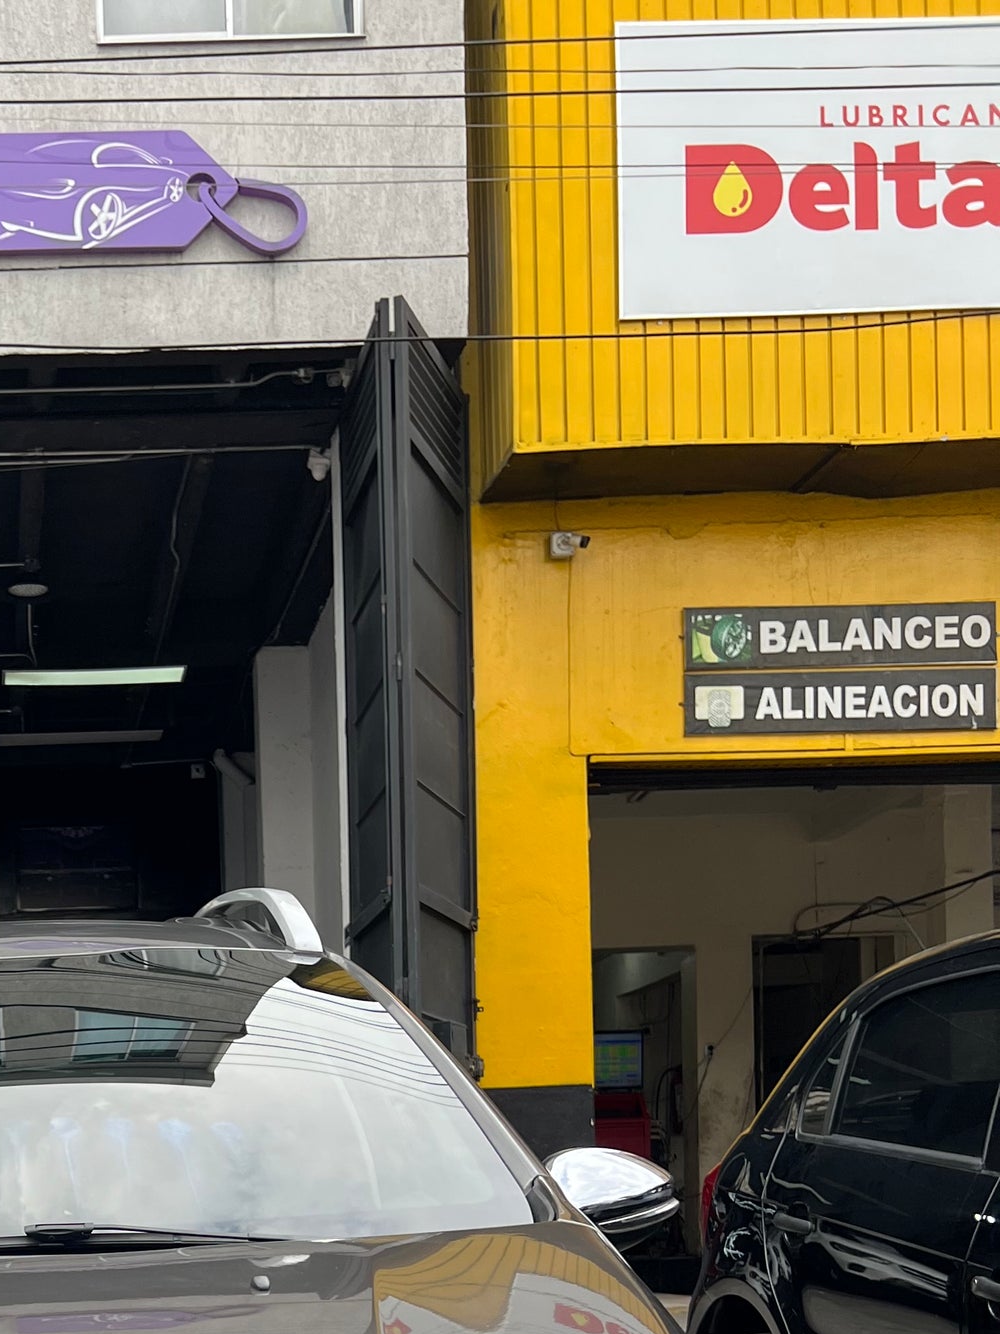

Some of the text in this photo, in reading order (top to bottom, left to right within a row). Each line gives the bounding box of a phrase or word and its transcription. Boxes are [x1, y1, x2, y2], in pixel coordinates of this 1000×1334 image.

[685, 140, 1000, 235] Delta
[758, 613, 992, 655] BALANCEO
[754, 682, 985, 721] ALINEACION
